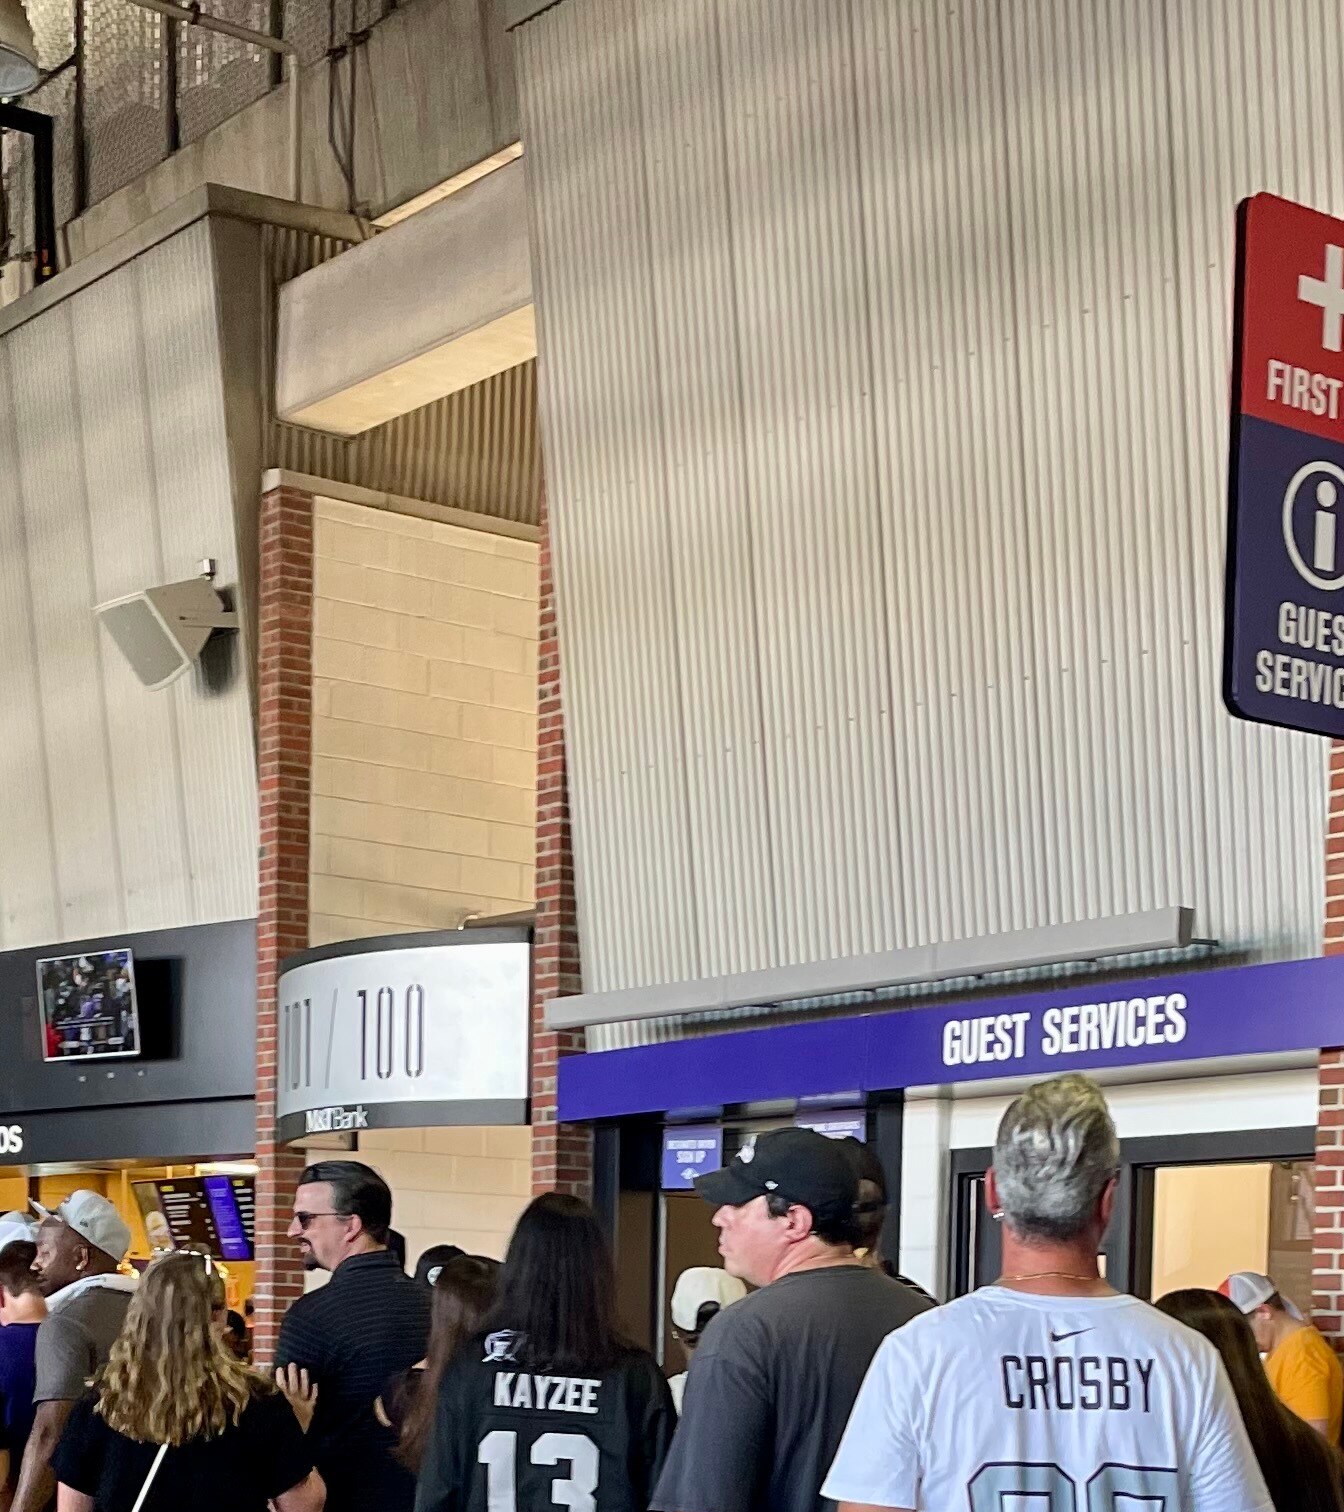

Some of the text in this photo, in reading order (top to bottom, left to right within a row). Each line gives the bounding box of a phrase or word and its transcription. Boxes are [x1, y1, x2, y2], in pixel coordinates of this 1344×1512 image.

[1266, 358, 1343, 421] FIRST
[357, 984, 424, 1080] 100
[942, 993, 1187, 1066] GUEST SERVICES
[493, 1371, 603, 1414] KAYZEE
[1001, 1355, 1155, 1413] CROSBY
